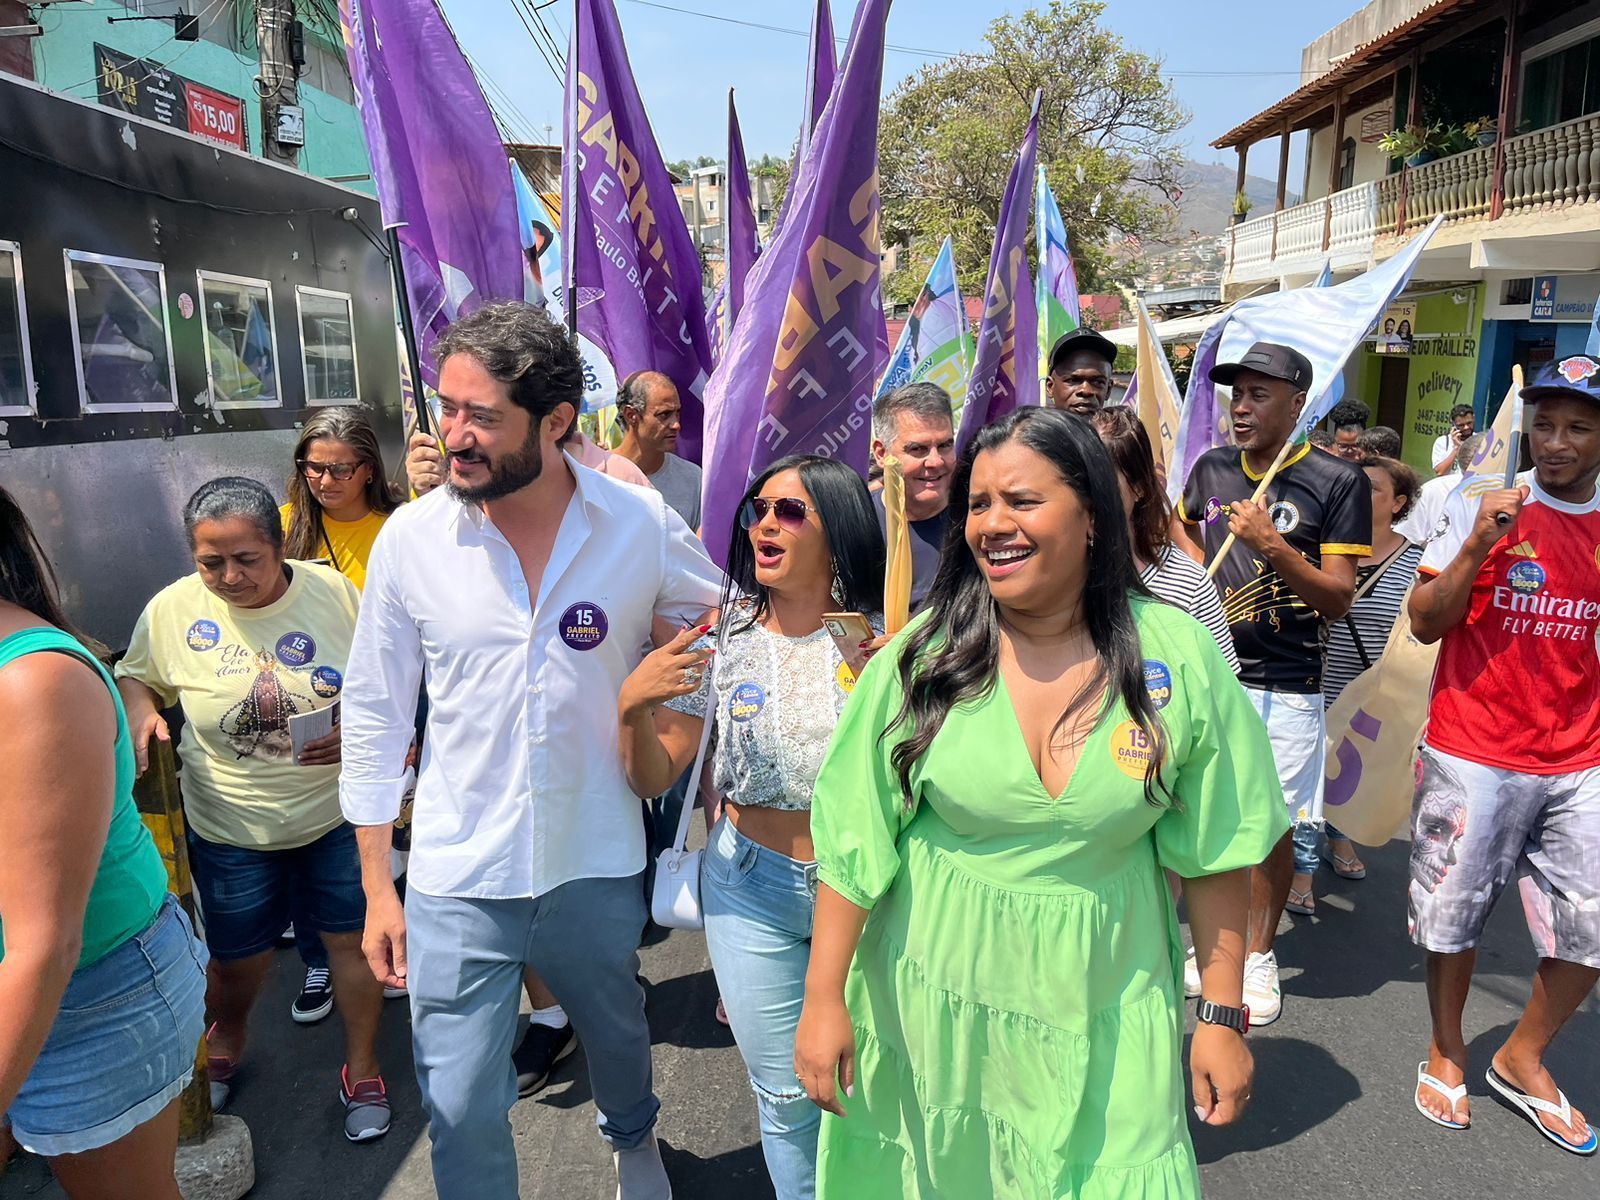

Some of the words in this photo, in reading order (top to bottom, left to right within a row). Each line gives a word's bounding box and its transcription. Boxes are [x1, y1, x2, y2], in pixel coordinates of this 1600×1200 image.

[1432, 339, 1475, 358] TRAILLER
[1418, 370, 1463, 405] Delivery
[576, 609, 593, 626] 15
[1502, 616, 1531, 634] FLY
[567, 626, 600, 634] GABRIEL
[291, 637, 308, 651] 15
[1128, 729, 1150, 750] 15
[1118, 747, 1153, 761] GABRIE
